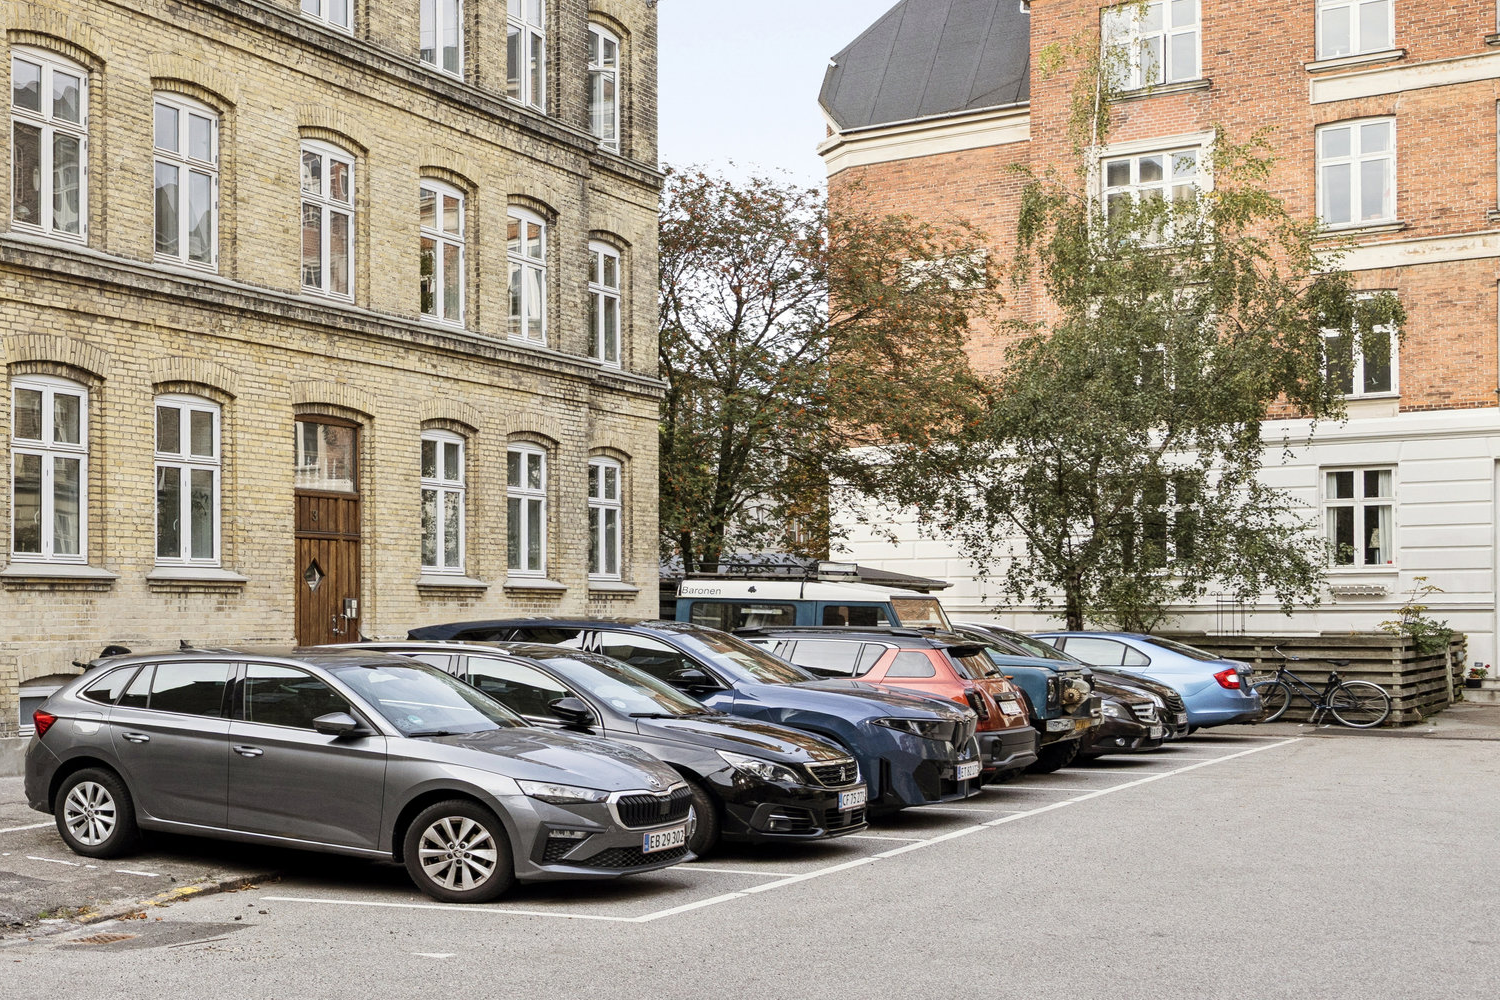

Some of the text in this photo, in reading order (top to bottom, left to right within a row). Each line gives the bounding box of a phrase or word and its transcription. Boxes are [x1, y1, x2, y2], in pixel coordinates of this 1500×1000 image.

[681, 586, 722, 595] Baronen
[650, 829, 684, 849] EB 29 302
